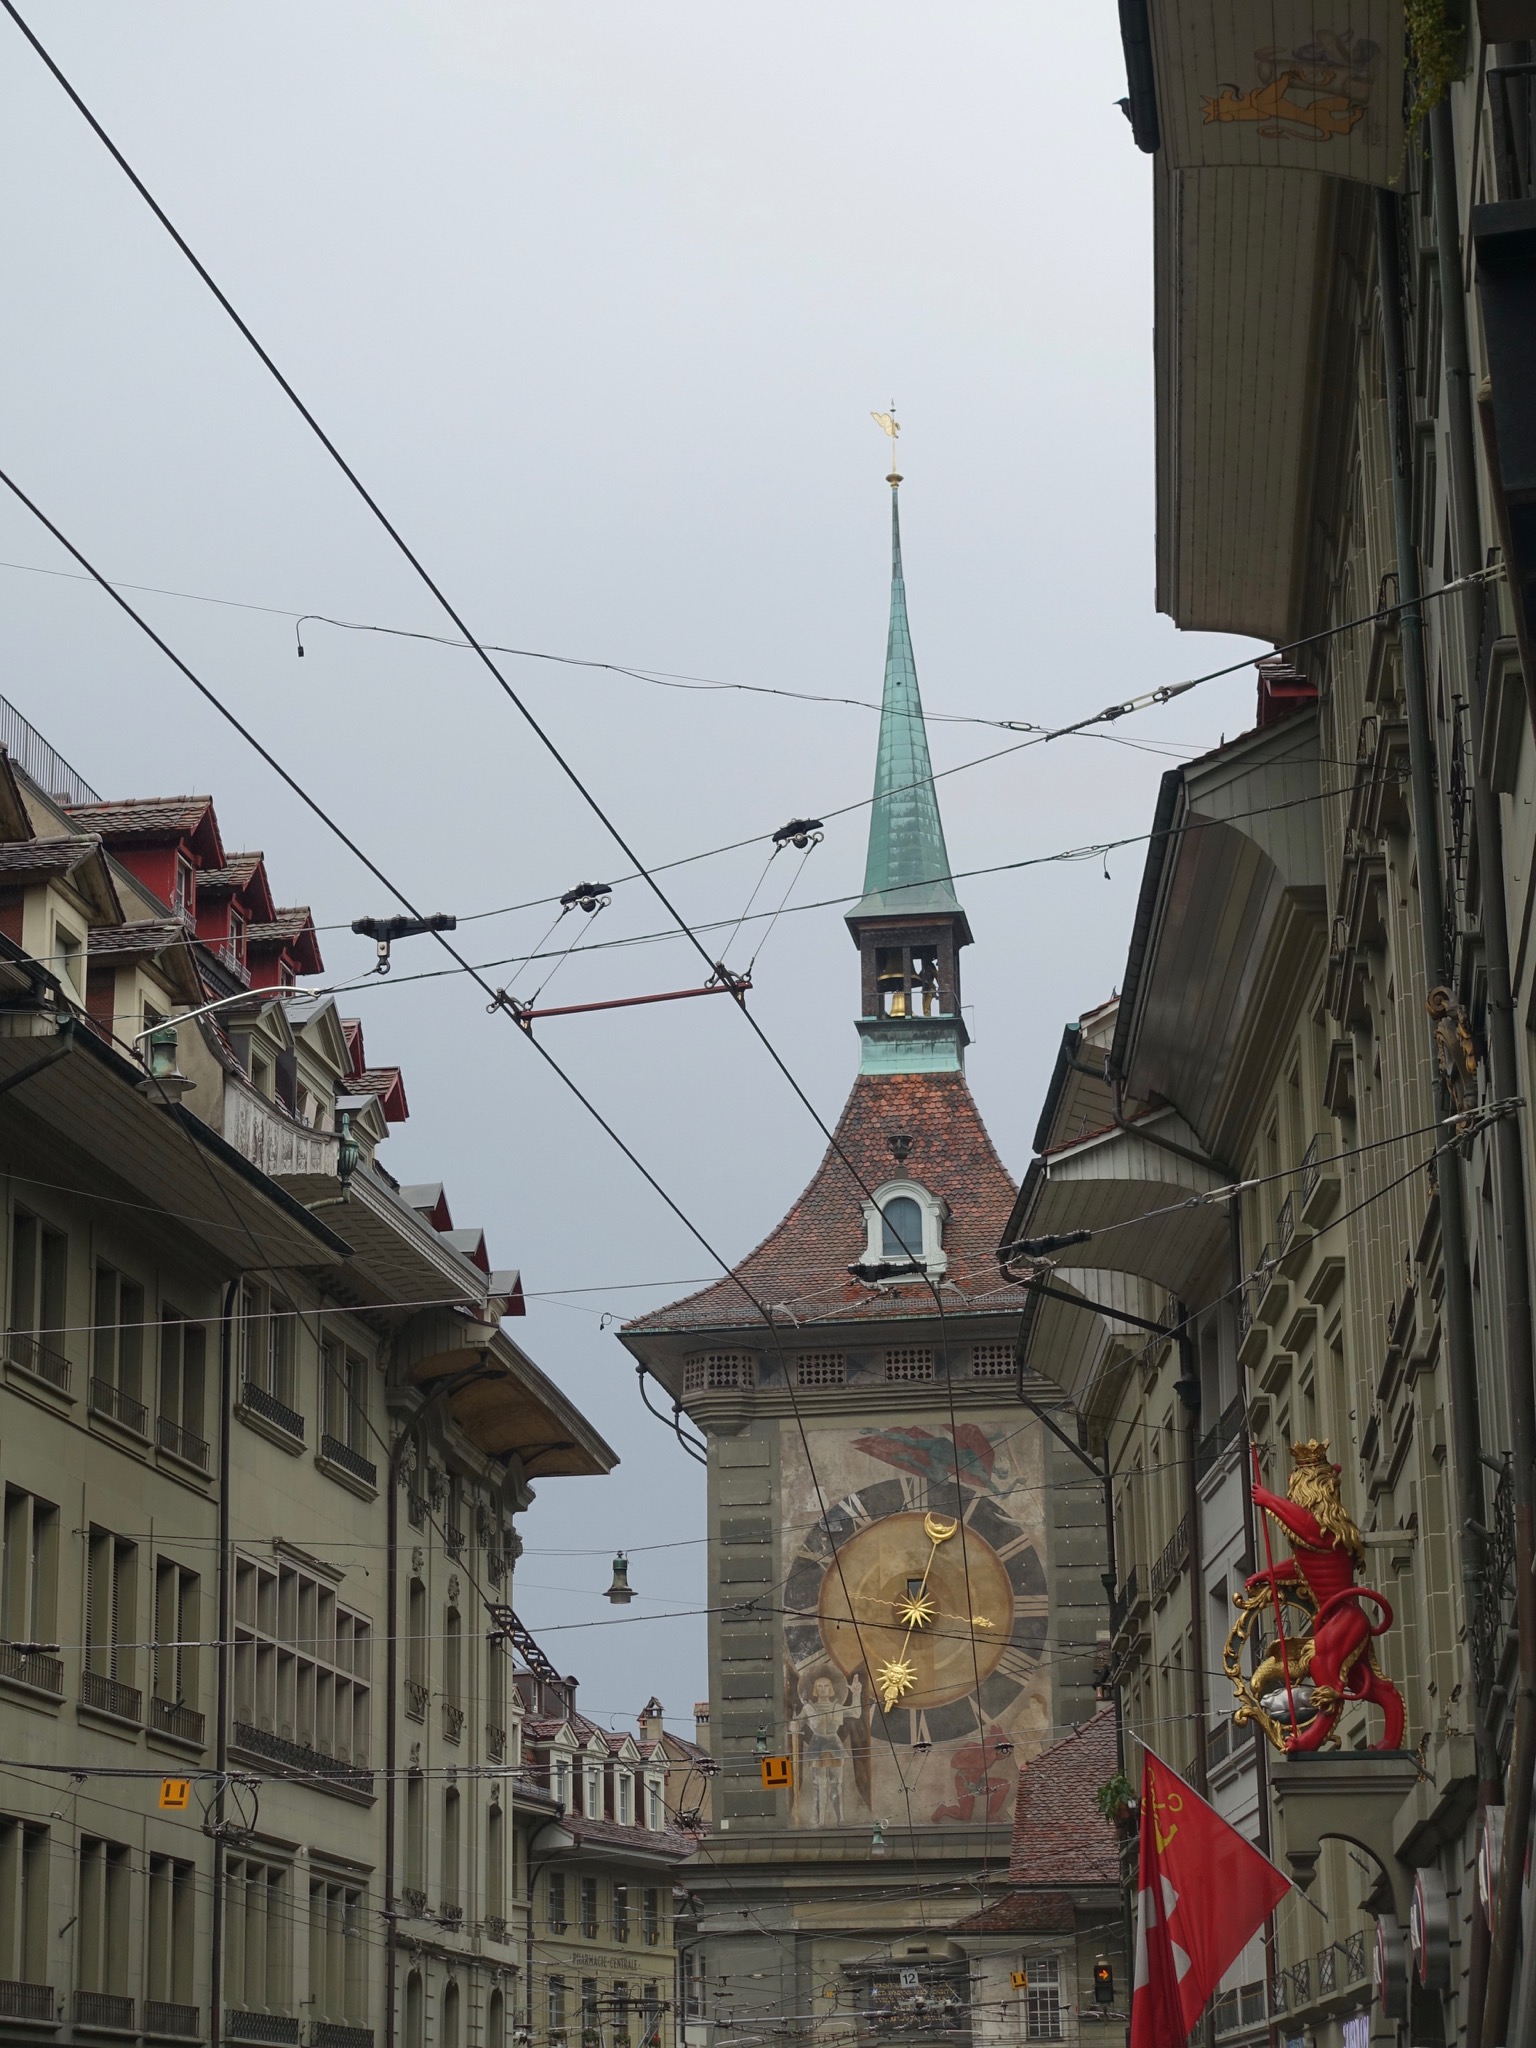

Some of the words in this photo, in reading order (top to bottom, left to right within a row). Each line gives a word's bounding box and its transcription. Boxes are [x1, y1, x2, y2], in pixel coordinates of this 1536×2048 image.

[899, 1477, 928, 1512] XII
[1013, 1595, 1048, 1617] III
[902, 1973, 916, 1985] 12
